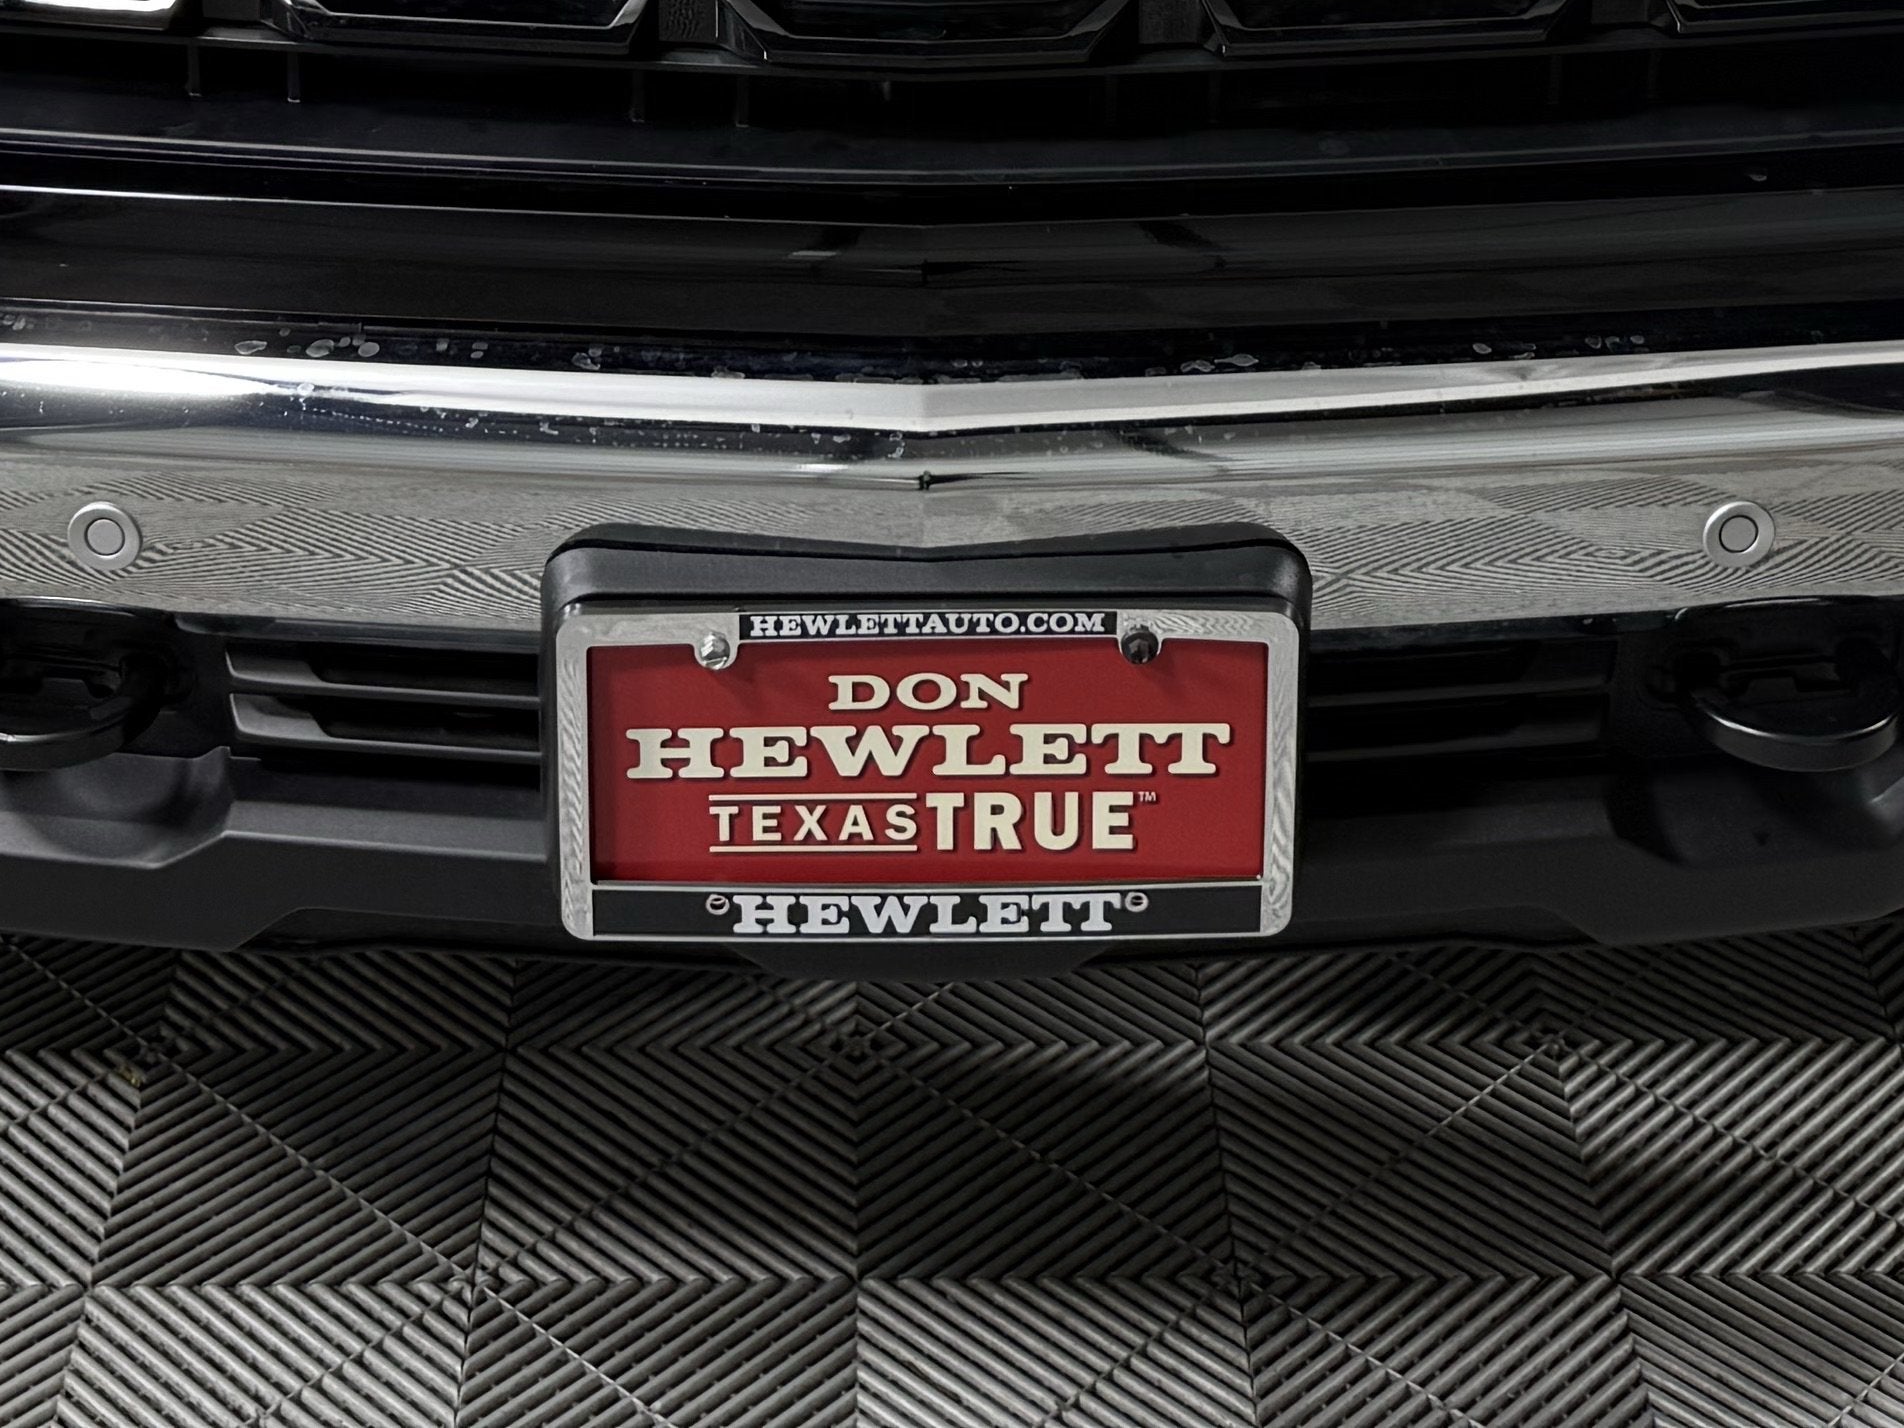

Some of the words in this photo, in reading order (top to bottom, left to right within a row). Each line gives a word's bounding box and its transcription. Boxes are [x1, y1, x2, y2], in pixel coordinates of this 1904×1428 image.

[750, 613, 1106, 637] HEWLETTAUTO.COM
[828, 673, 1029, 711] DON
[626, 723, 1231, 779] HEWLETT
[733, 893, 1121, 935] HEWLETT
